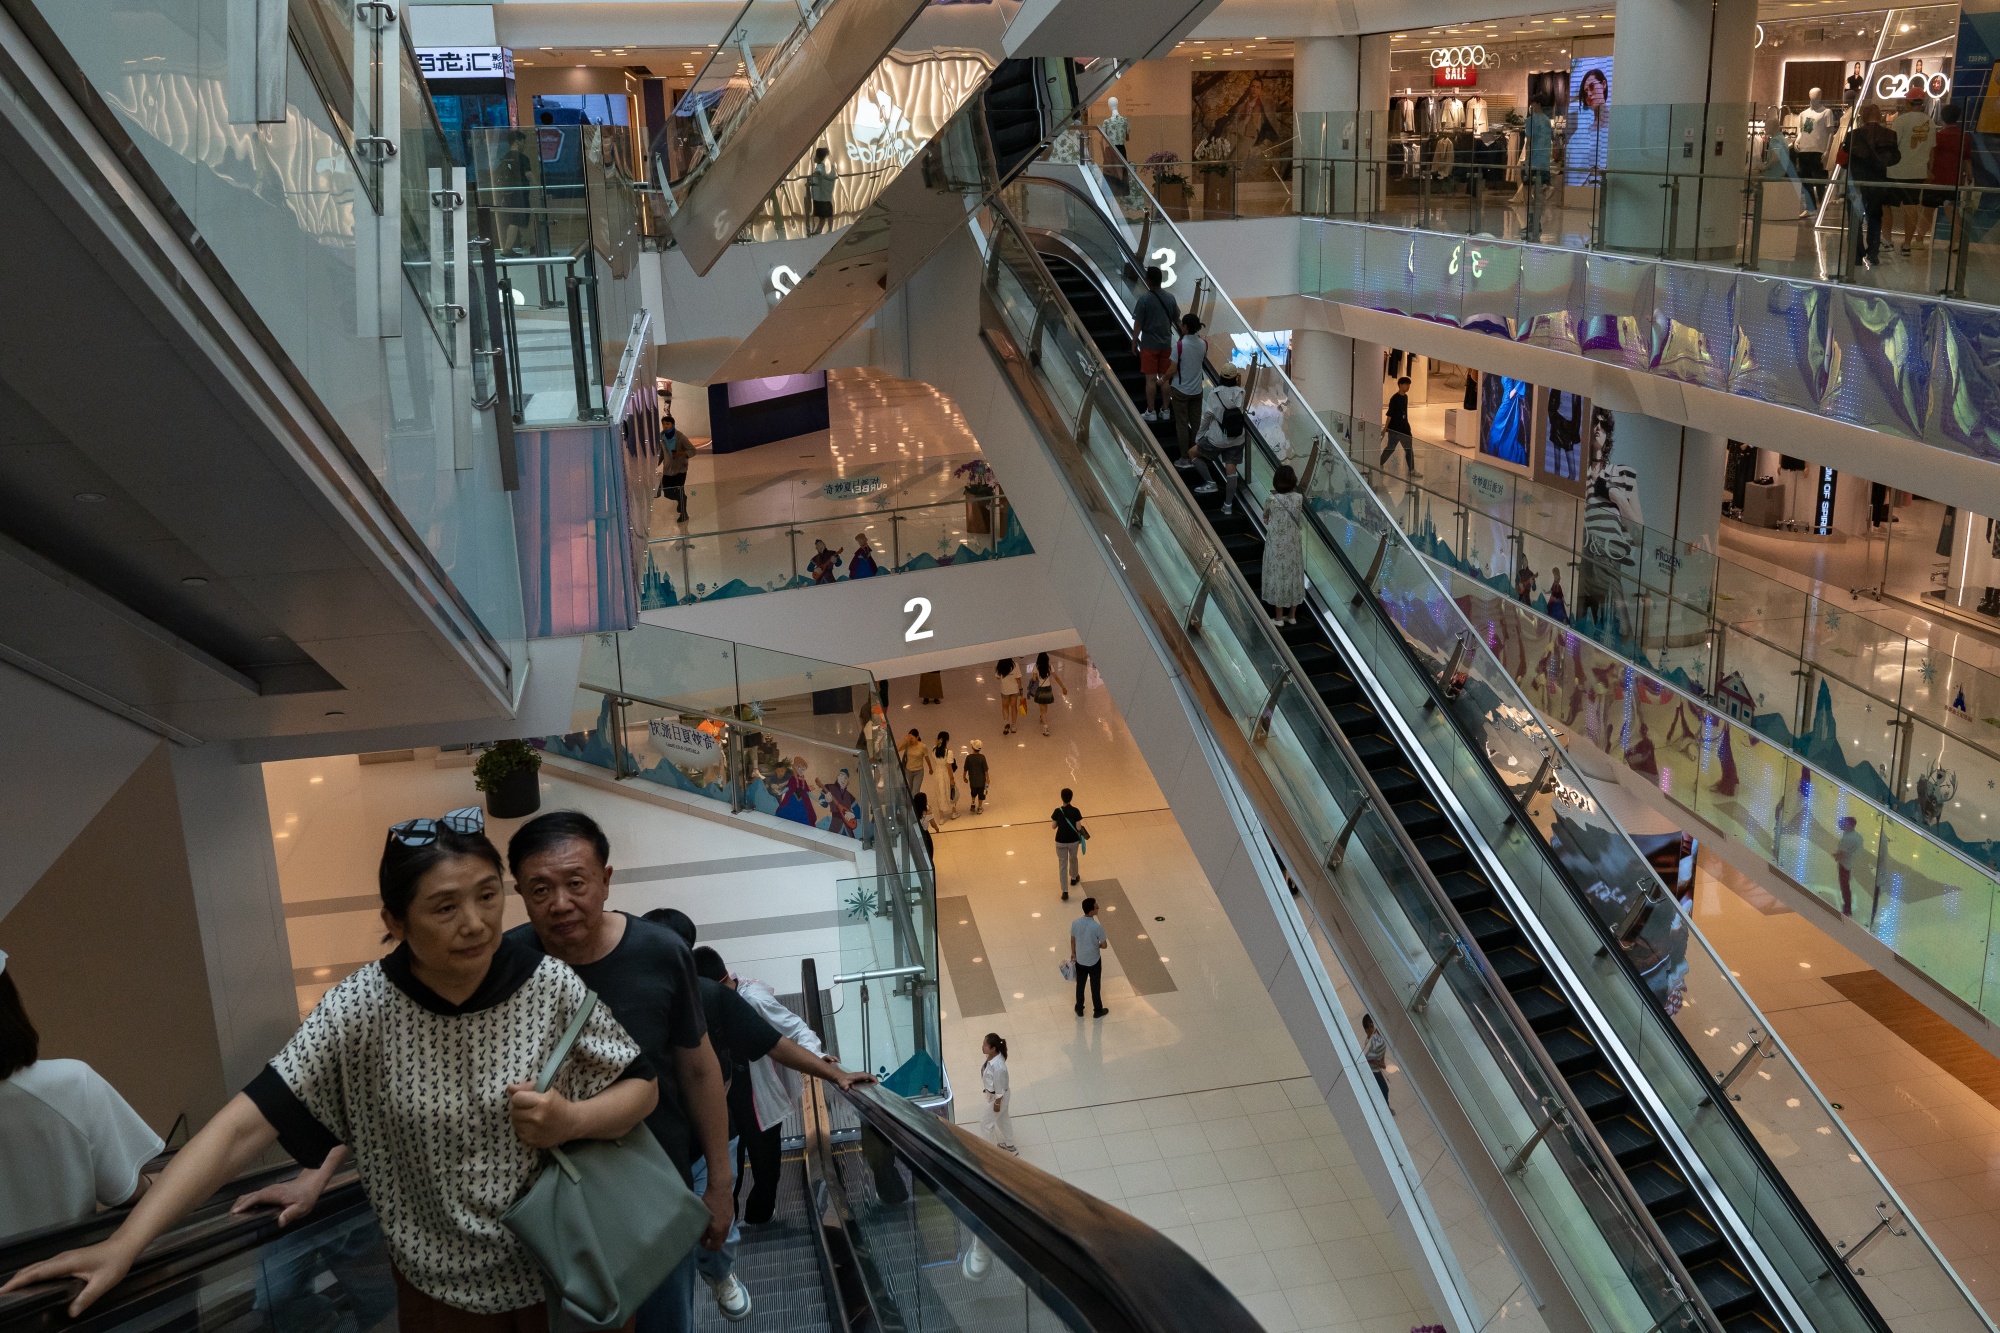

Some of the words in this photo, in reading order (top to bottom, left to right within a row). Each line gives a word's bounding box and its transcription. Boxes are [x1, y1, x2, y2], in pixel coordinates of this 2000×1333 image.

[416, 52, 491, 71] 百老汇
[1430, 45, 1485, 68] G2000
[1445, 67, 1467, 80] SALE
[1876, 72, 1951, 99] G200
[1151, 247, 1177, 288] 3
[1823, 483, 1831, 499] OF
[904, 597, 934, 642] 2
